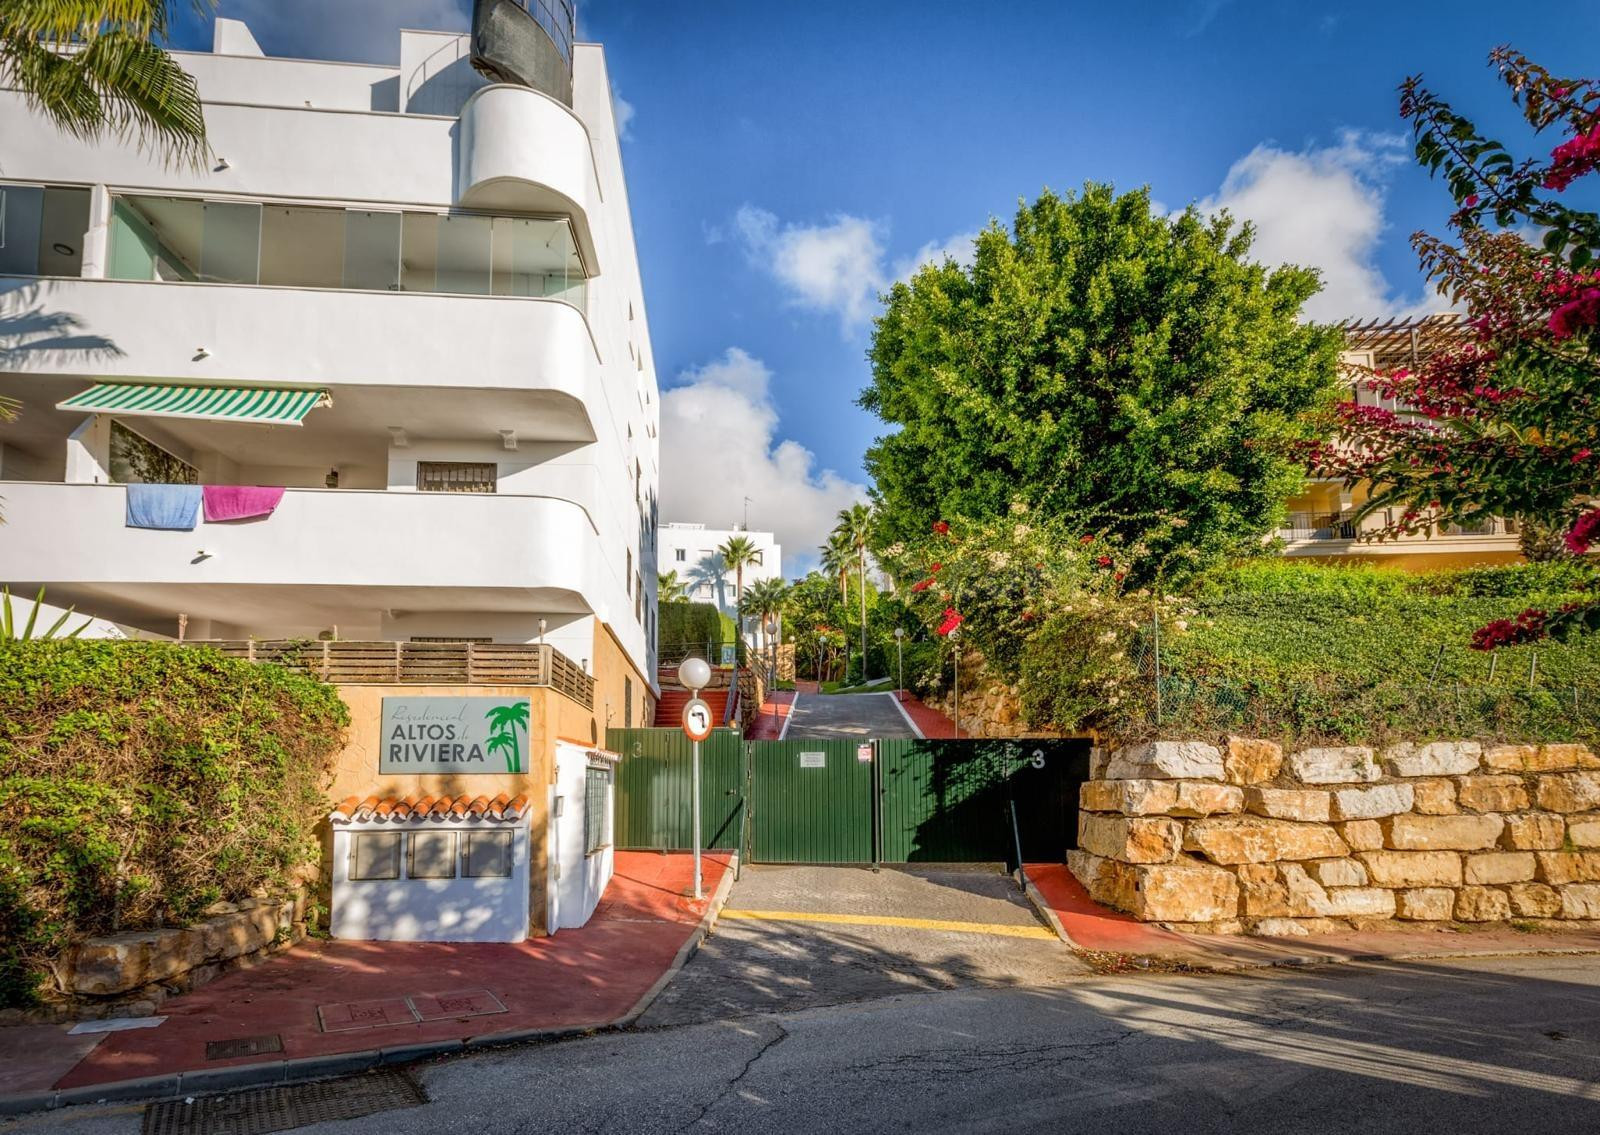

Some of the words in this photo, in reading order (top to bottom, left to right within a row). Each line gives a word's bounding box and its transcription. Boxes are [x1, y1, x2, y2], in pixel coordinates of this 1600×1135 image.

[391, 724, 456, 740] ALTOS
[389, 743, 485, 763] RIVIERA
[1031, 748, 1046, 769] 3
